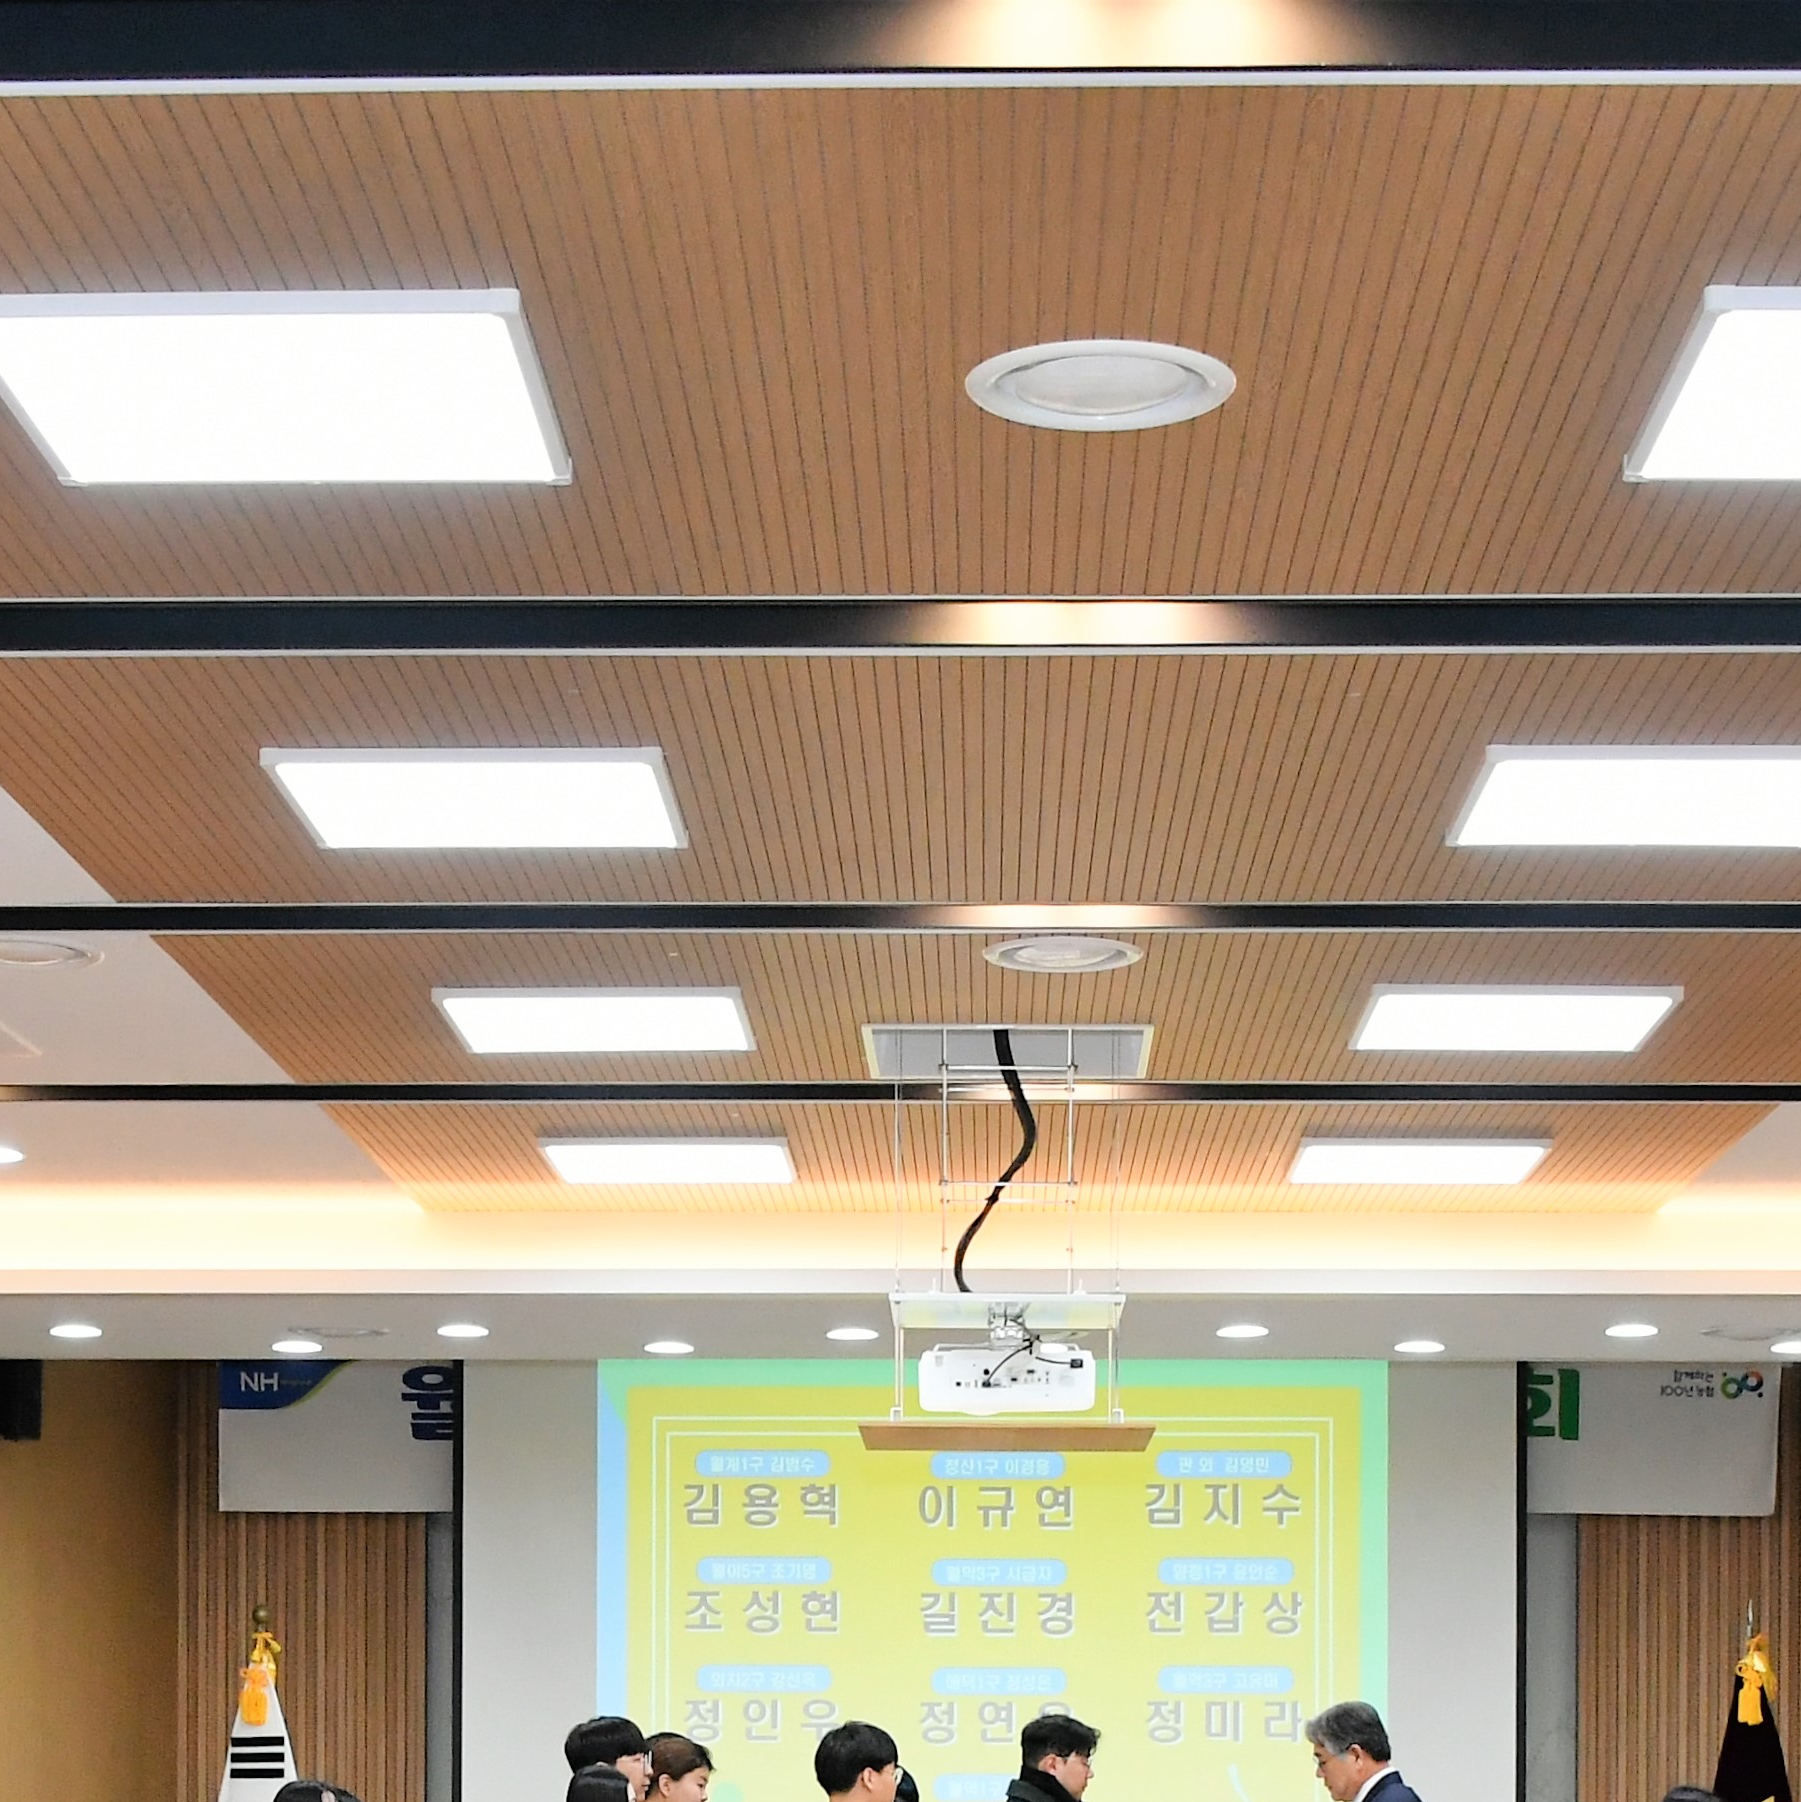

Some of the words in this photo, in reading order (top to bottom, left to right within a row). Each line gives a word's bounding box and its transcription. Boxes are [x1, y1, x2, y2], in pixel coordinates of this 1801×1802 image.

[240, 1371, 279, 1392] NH
[684, 1483, 838, 1527] 김용혁
[919, 1485, 1072, 1529] 이규연
[1145, 1483, 1301, 1527] 김지수
[685, 1590, 839, 1634] 조성현
[920, 1592, 1074, 1636] 길진경
[1146, 1591, 1303, 1636] 전갑상
